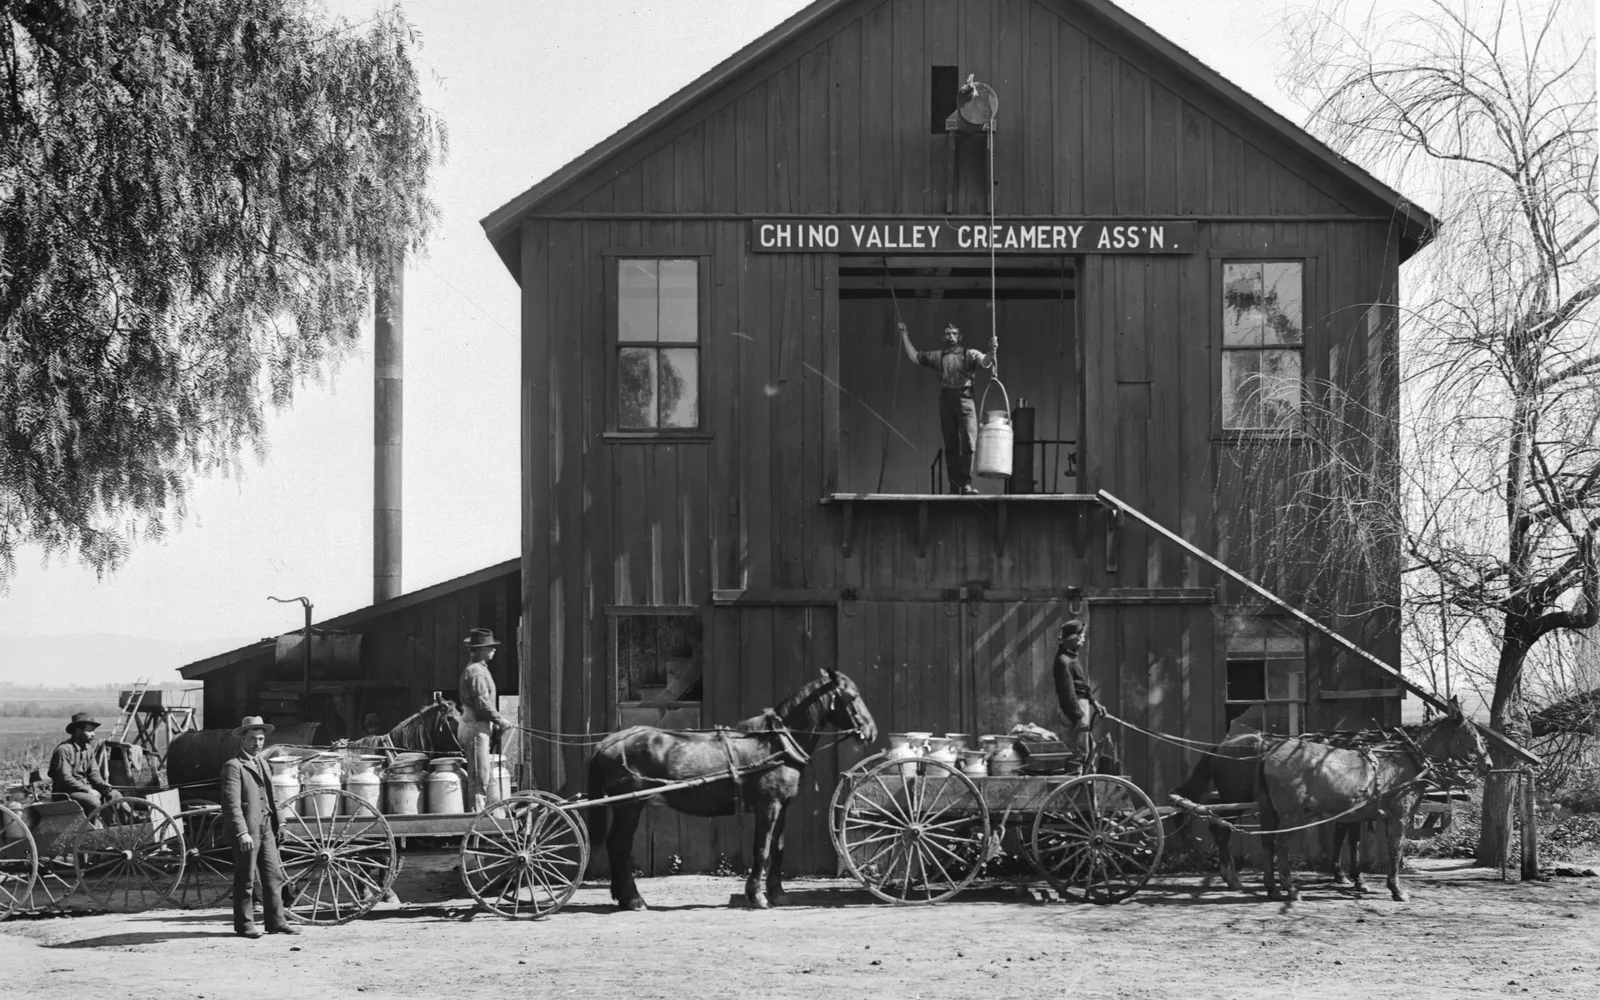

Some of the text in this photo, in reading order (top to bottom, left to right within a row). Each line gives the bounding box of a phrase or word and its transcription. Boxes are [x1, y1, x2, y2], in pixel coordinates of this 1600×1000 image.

[760, 224, 839, 247] CHINO
[850, 225, 941, 248] VALLEY
[957, 225, 1084, 248] CREAMERY
